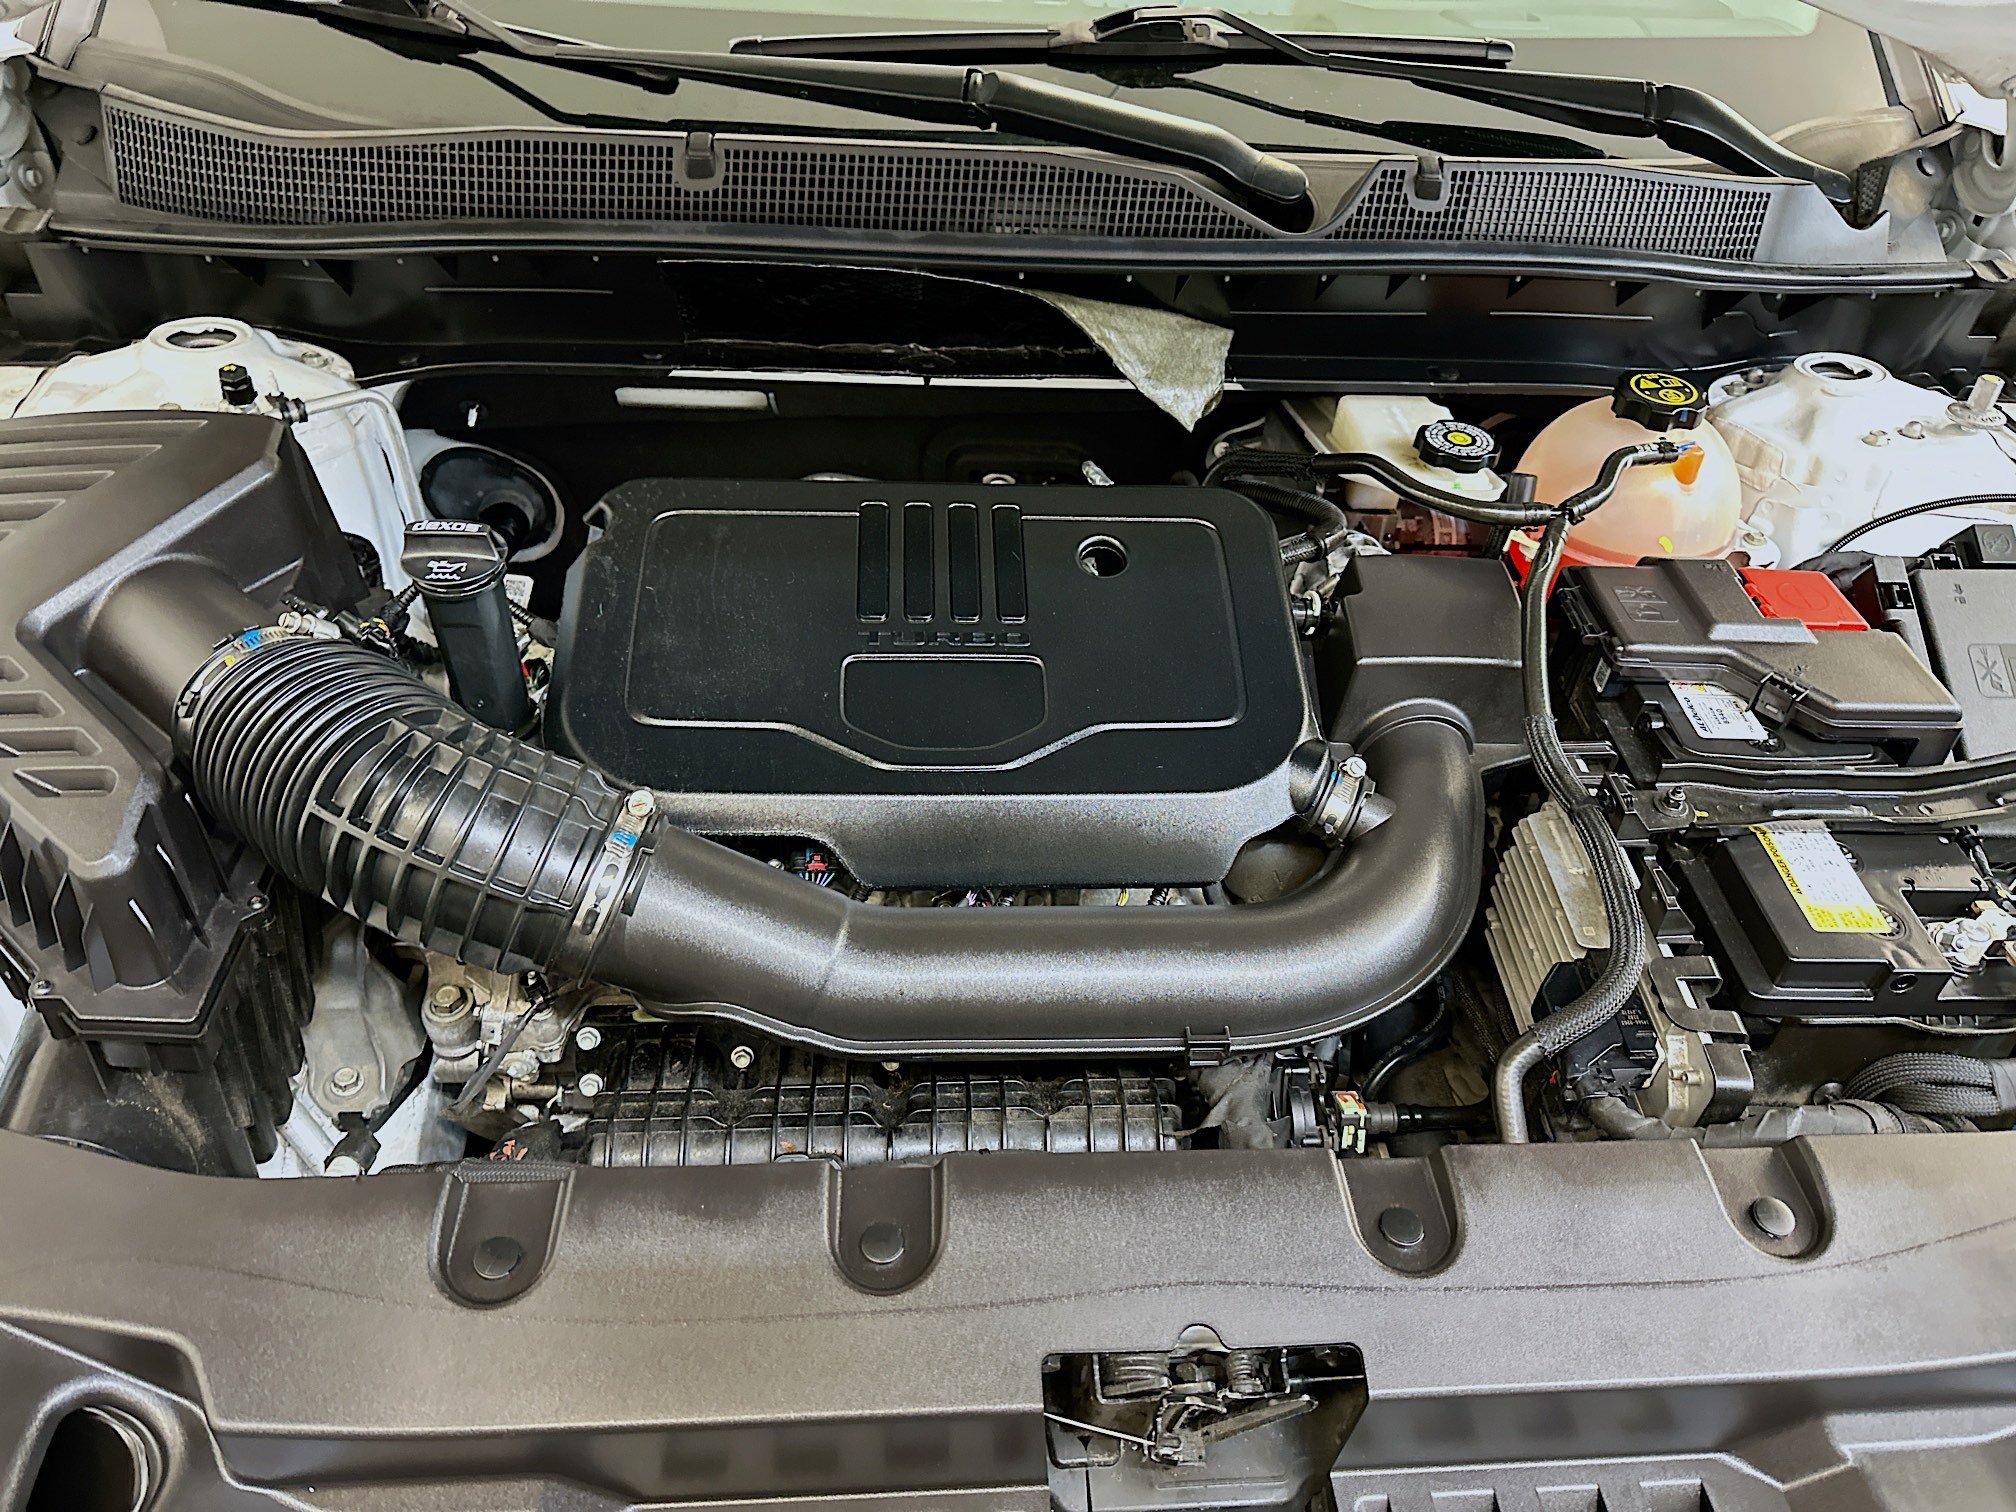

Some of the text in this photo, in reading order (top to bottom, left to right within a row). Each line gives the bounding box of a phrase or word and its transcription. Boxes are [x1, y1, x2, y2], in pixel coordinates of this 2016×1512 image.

[411, 520, 483, 532] dexos
[858, 631, 1031, 646] TURBO
[1760, 830, 1798, 887] DANGER POISON
